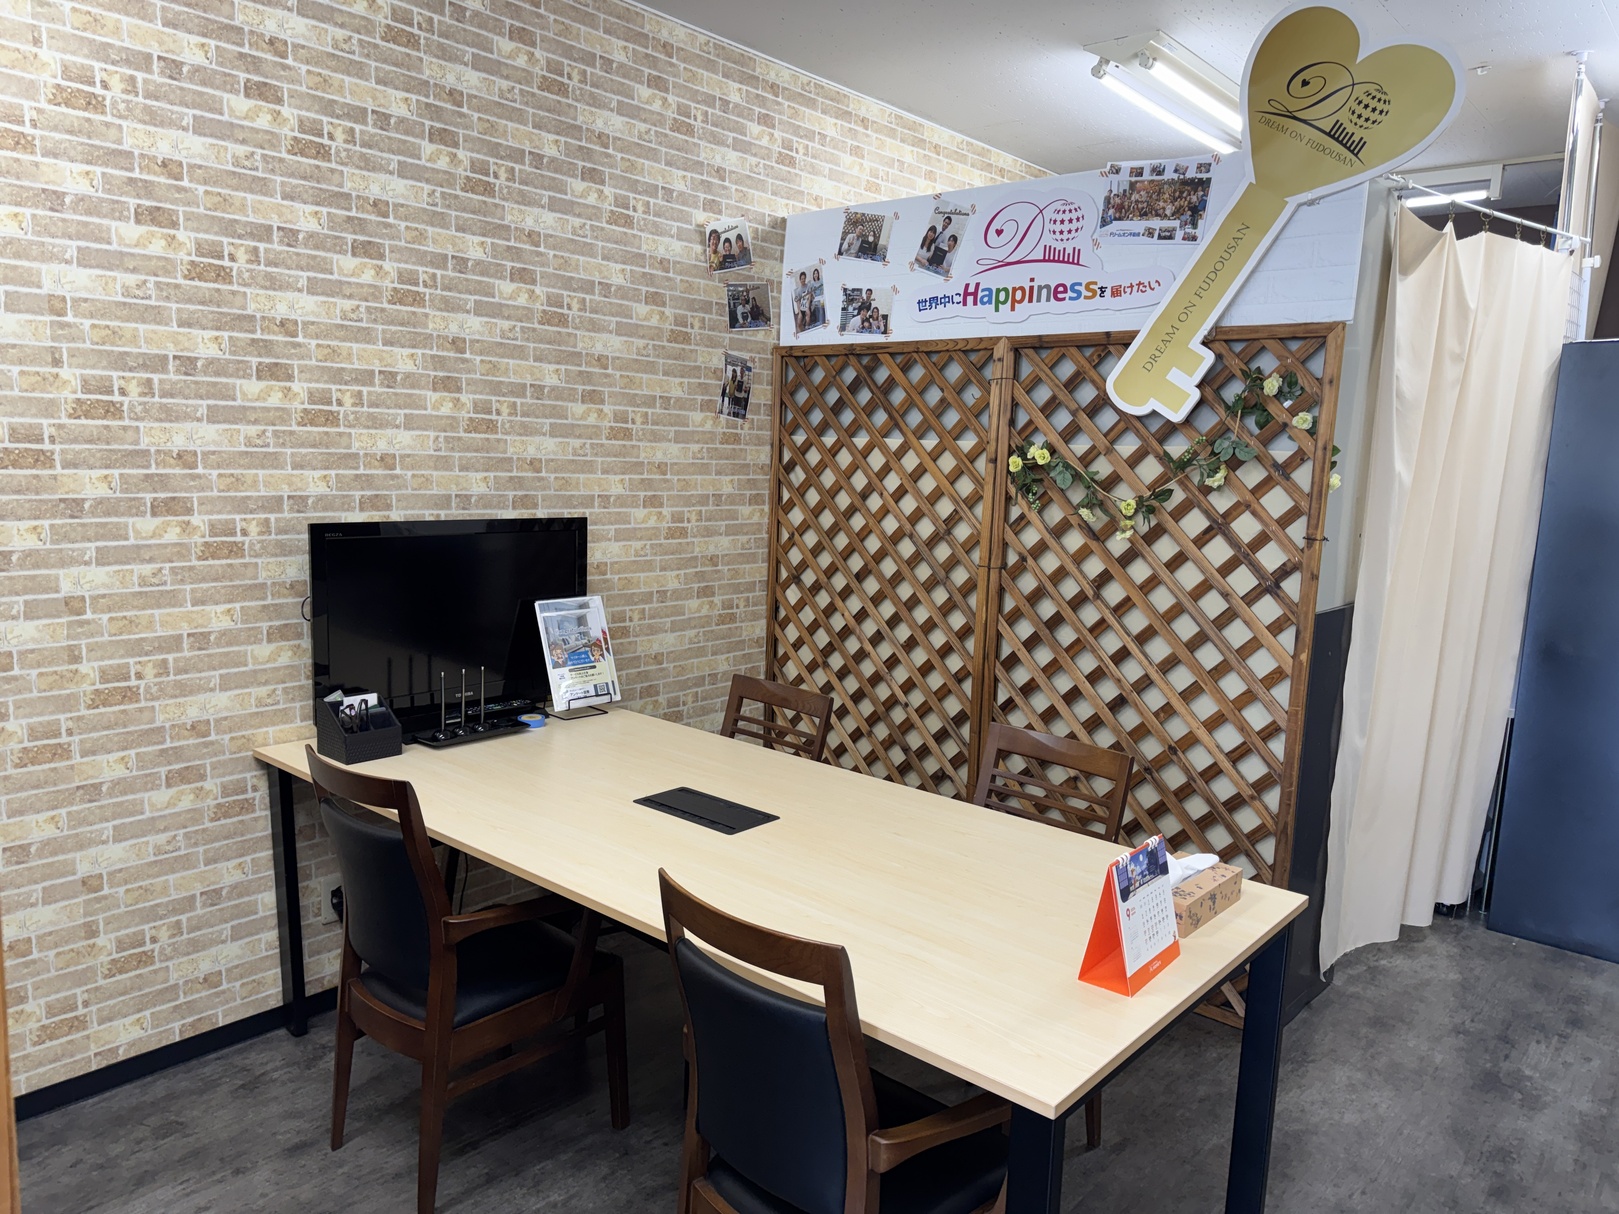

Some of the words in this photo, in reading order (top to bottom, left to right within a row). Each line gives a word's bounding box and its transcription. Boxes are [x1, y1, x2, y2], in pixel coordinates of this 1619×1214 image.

[1258, 115, 1290, 135] DREAM
[1289, 129, 1305, 143] ON
[1305, 138, 1357, 168] FUDOUSAN
[962, 277, 1099, 313] Happiness
[1142, 324, 1180, 372] DREAM
[1177, 300, 1197, 323] ON
[1194, 222, 1251, 299] FUDOUSAN
